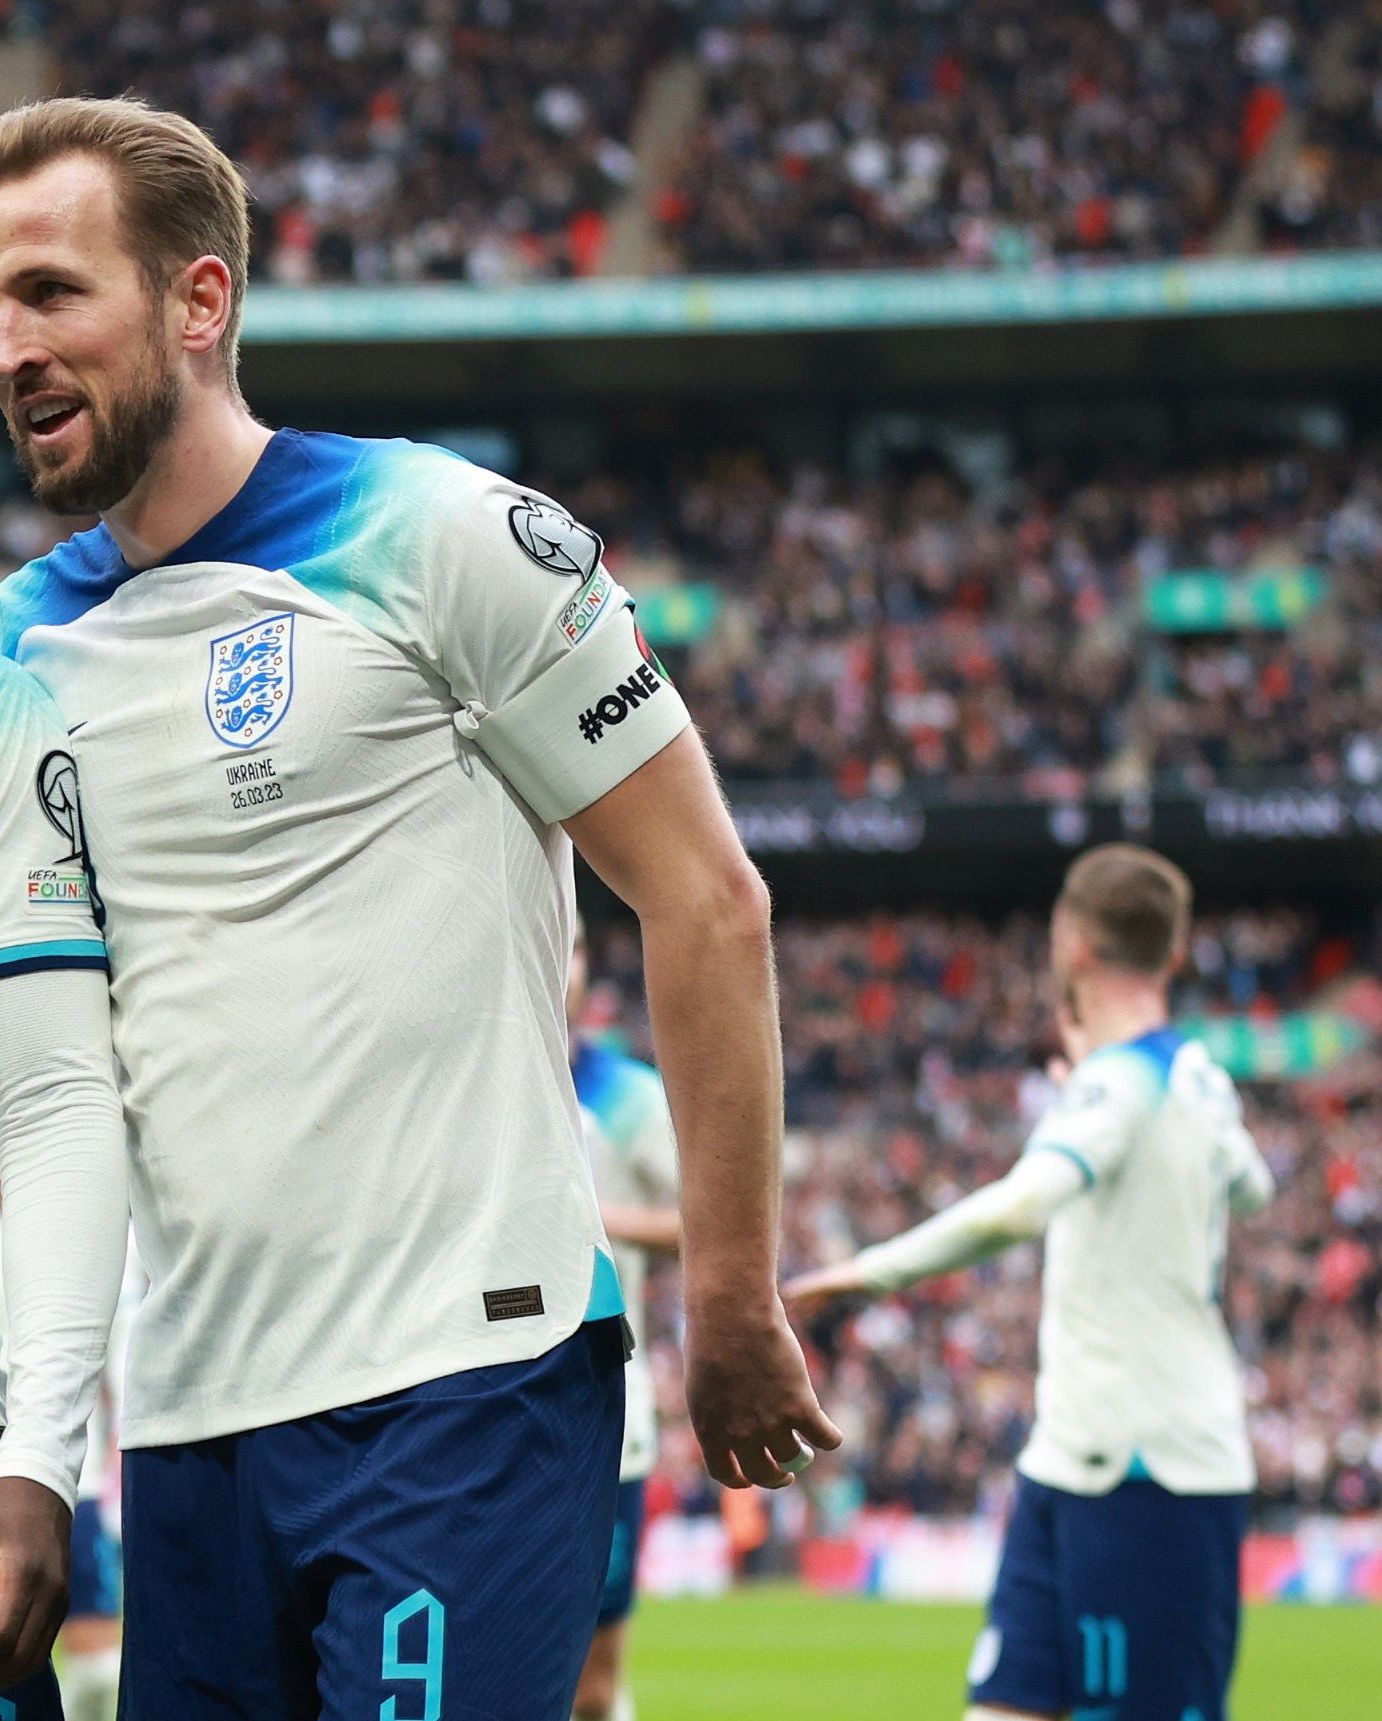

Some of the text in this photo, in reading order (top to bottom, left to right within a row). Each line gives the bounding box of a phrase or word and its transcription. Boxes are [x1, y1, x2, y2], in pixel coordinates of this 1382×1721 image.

[578, 663, 661, 744] #ONE
[230, 782, 283, 809] 26.03.23
[27, 869, 58, 881] UEFA
[28, 882, 89, 898] FOUND
[379, 1587, 445, 1721] 9
[1078, 1613, 1128, 1698] 11
